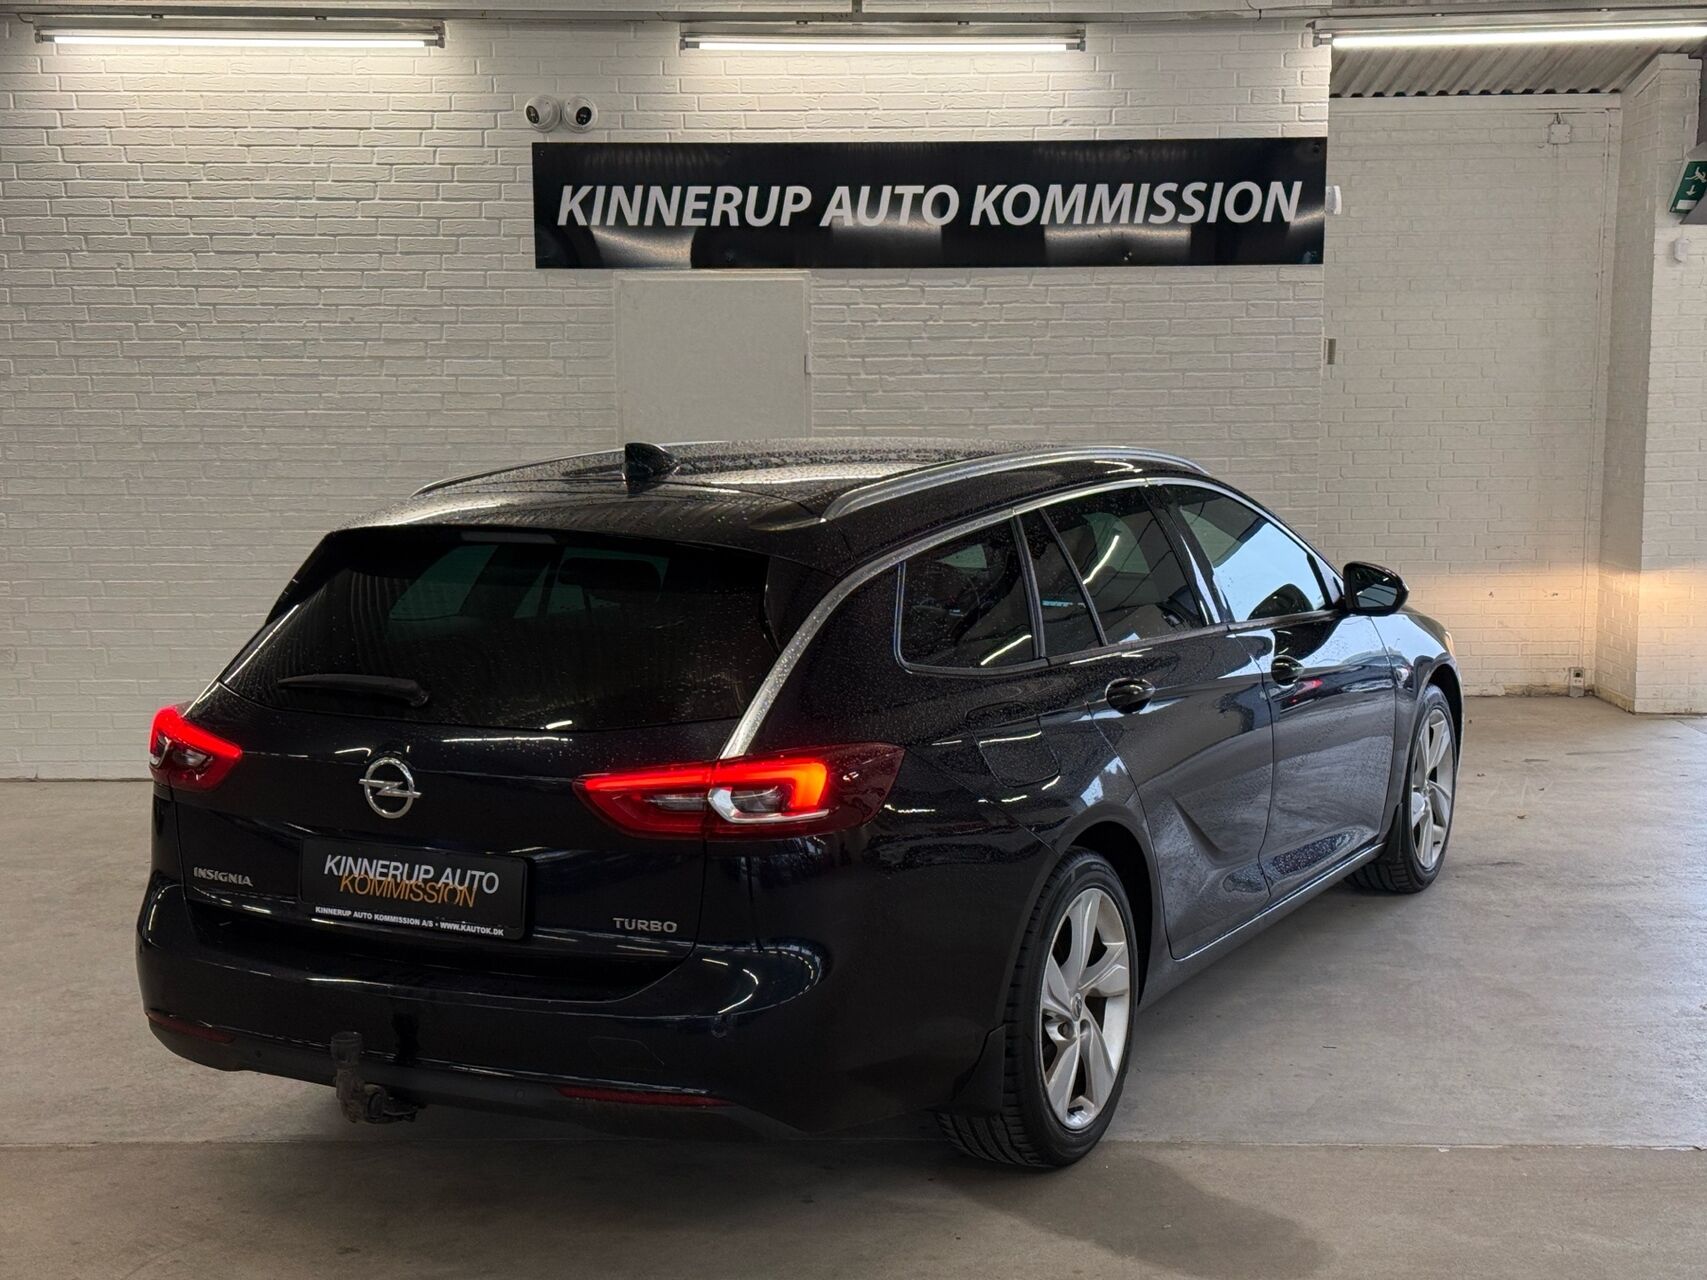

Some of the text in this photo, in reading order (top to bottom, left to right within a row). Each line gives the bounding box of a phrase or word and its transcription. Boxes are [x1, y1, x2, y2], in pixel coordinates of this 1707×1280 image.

[557, 181, 1303, 227] KINNERUP AUTO KOMMISSION
[193, 867, 254, 887] INSIGNIA
[323, 854, 499, 894] KINNERUP AUTO
[339, 874, 476, 908] KOMMISSION
[315, 906, 352, 917] KINNERUP
[353, 911, 373, 920] AUTO
[374, 913, 420, 926] KOMMISSION
[421, 919, 434, 928] A/S
[613, 917, 678, 933] TURBO
